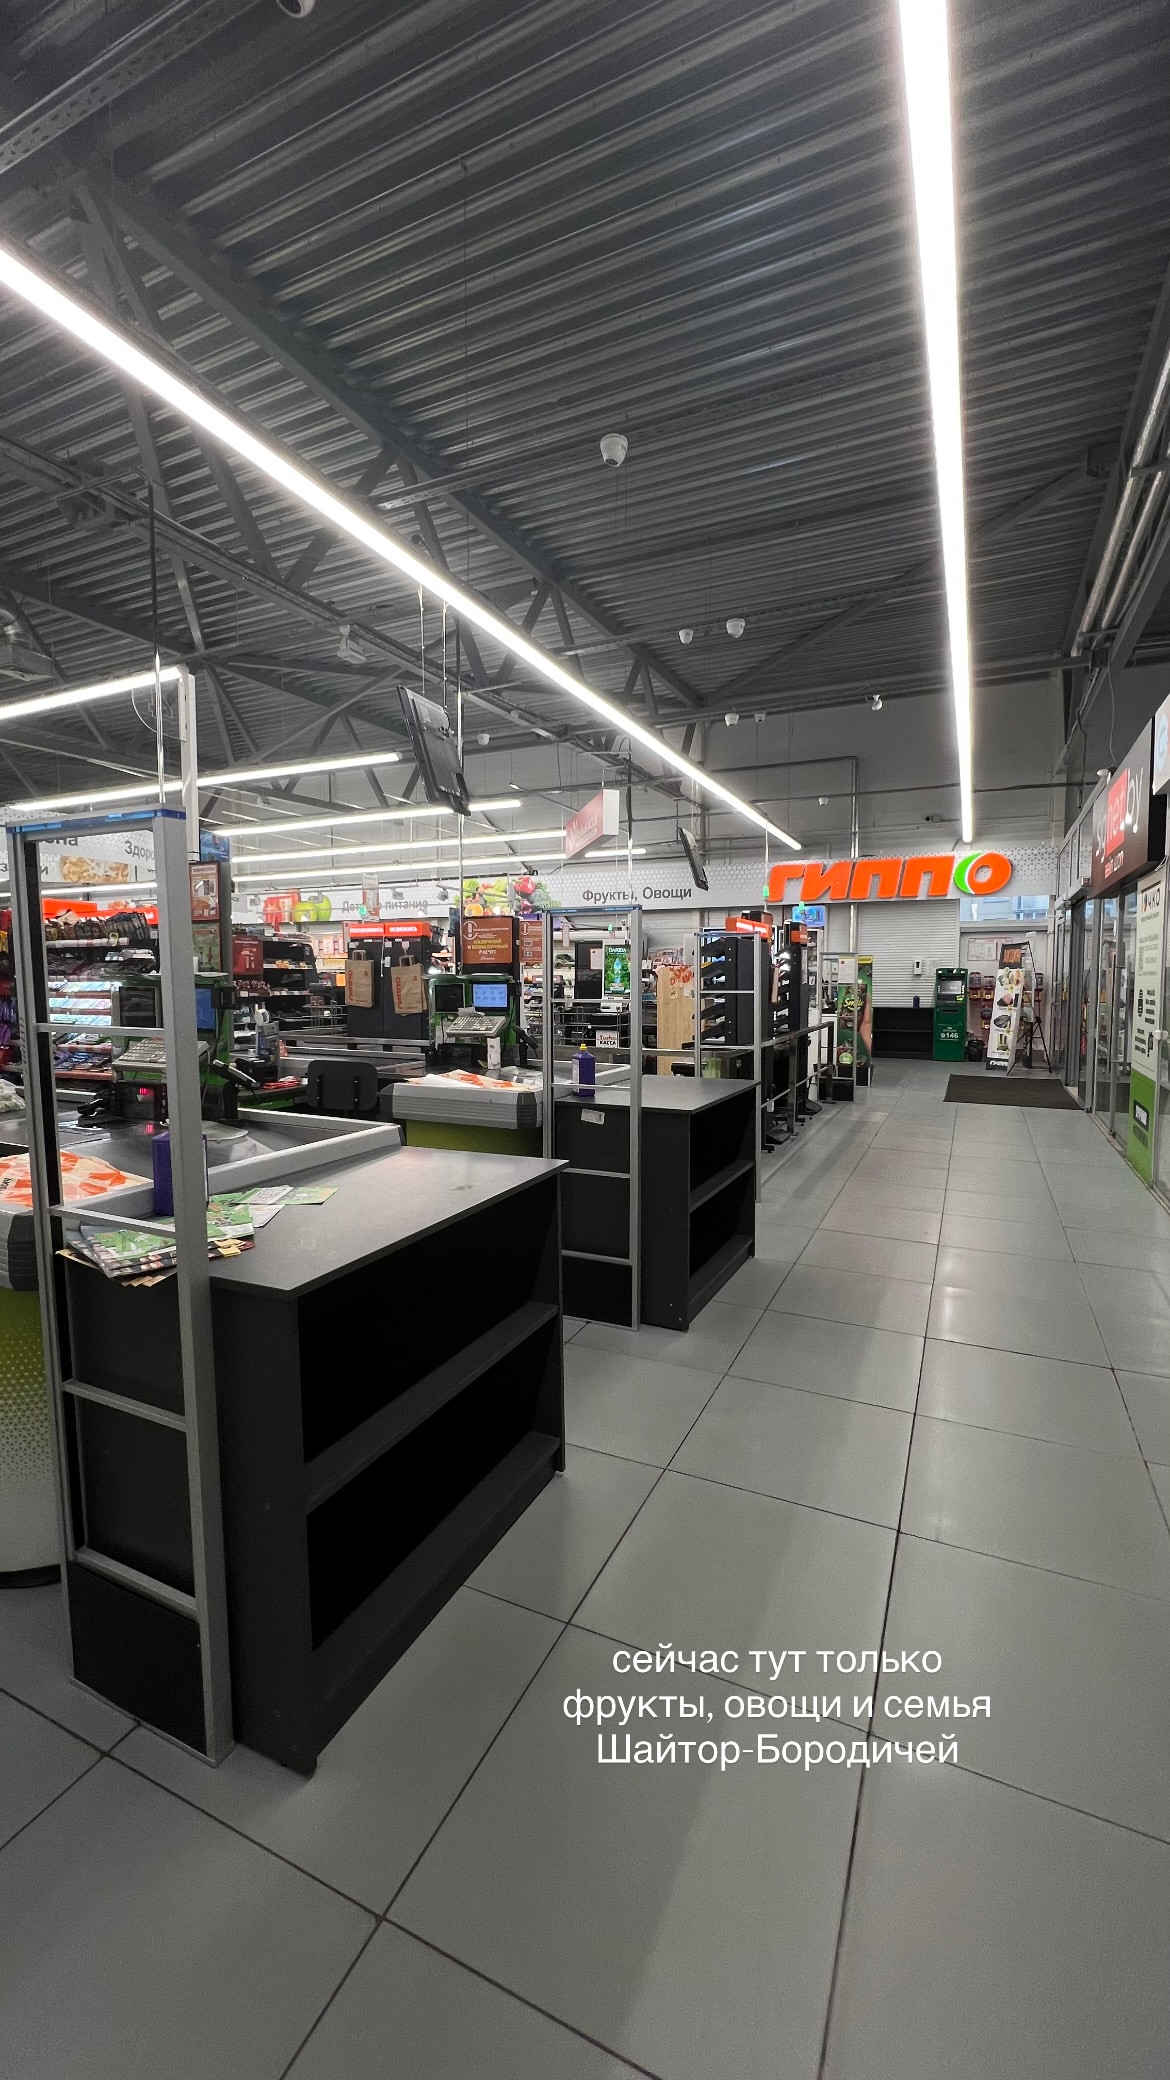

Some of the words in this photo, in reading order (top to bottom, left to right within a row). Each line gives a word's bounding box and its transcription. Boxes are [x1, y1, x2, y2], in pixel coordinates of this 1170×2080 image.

[768, 851, 1012, 902] ГИППО
[582, 889, 638, 904] Фрукты,
[642, 886, 692, 901] Овощи
